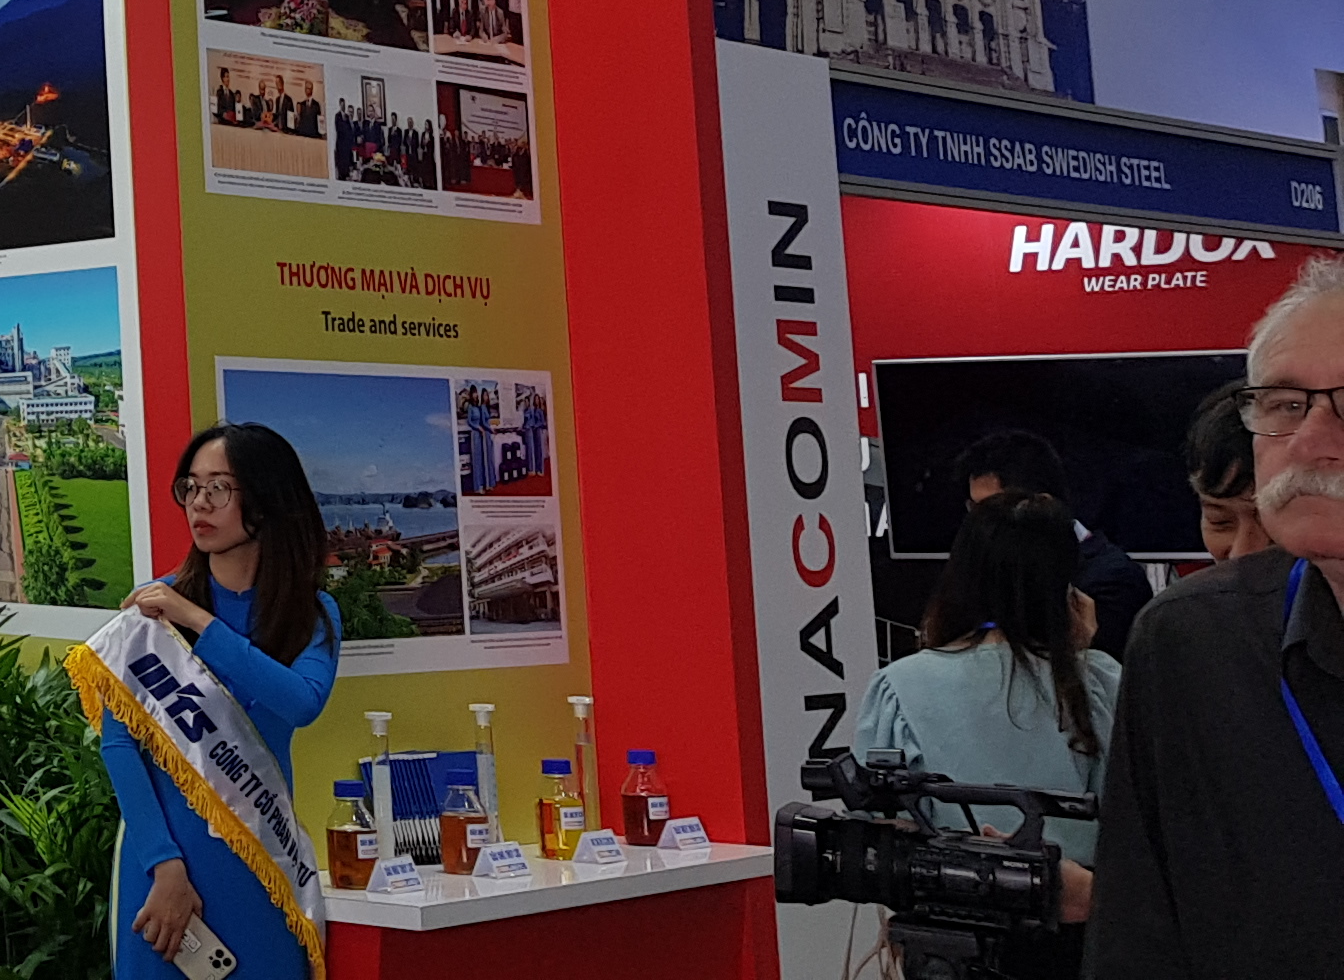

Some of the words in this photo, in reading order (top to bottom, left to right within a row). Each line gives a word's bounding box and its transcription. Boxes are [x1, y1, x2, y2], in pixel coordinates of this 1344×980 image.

[843, 111, 902, 155] CÔNG
[905, 126, 929, 158] TY
[934, 130, 986, 166] TNHH
[989, 137, 1038, 172] SSAB
[1041, 145, 1118, 183] SWEDISH
[1120, 157, 1171, 190] STEEL
[1291, 181, 1323, 210] D206
[276, 261, 356, 291] THƯƠNG
[361, 268, 393, 299] MẠI
[397, 267, 420, 295] VÀ
[424, 273, 465, 303] DỊCH
[467, 276, 490, 306] VỤ
[1083, 273, 1142, 292] WEAR
[1146, 271, 1208, 289] PLATE
[321, 311, 365, 334] Trade
[369, 314, 397, 335] and
[401, 317, 459, 339] services
[208, 741, 249, 783] CÔNG
[240, 773, 263, 798] TY
[253, 789, 278, 816] CỔ
